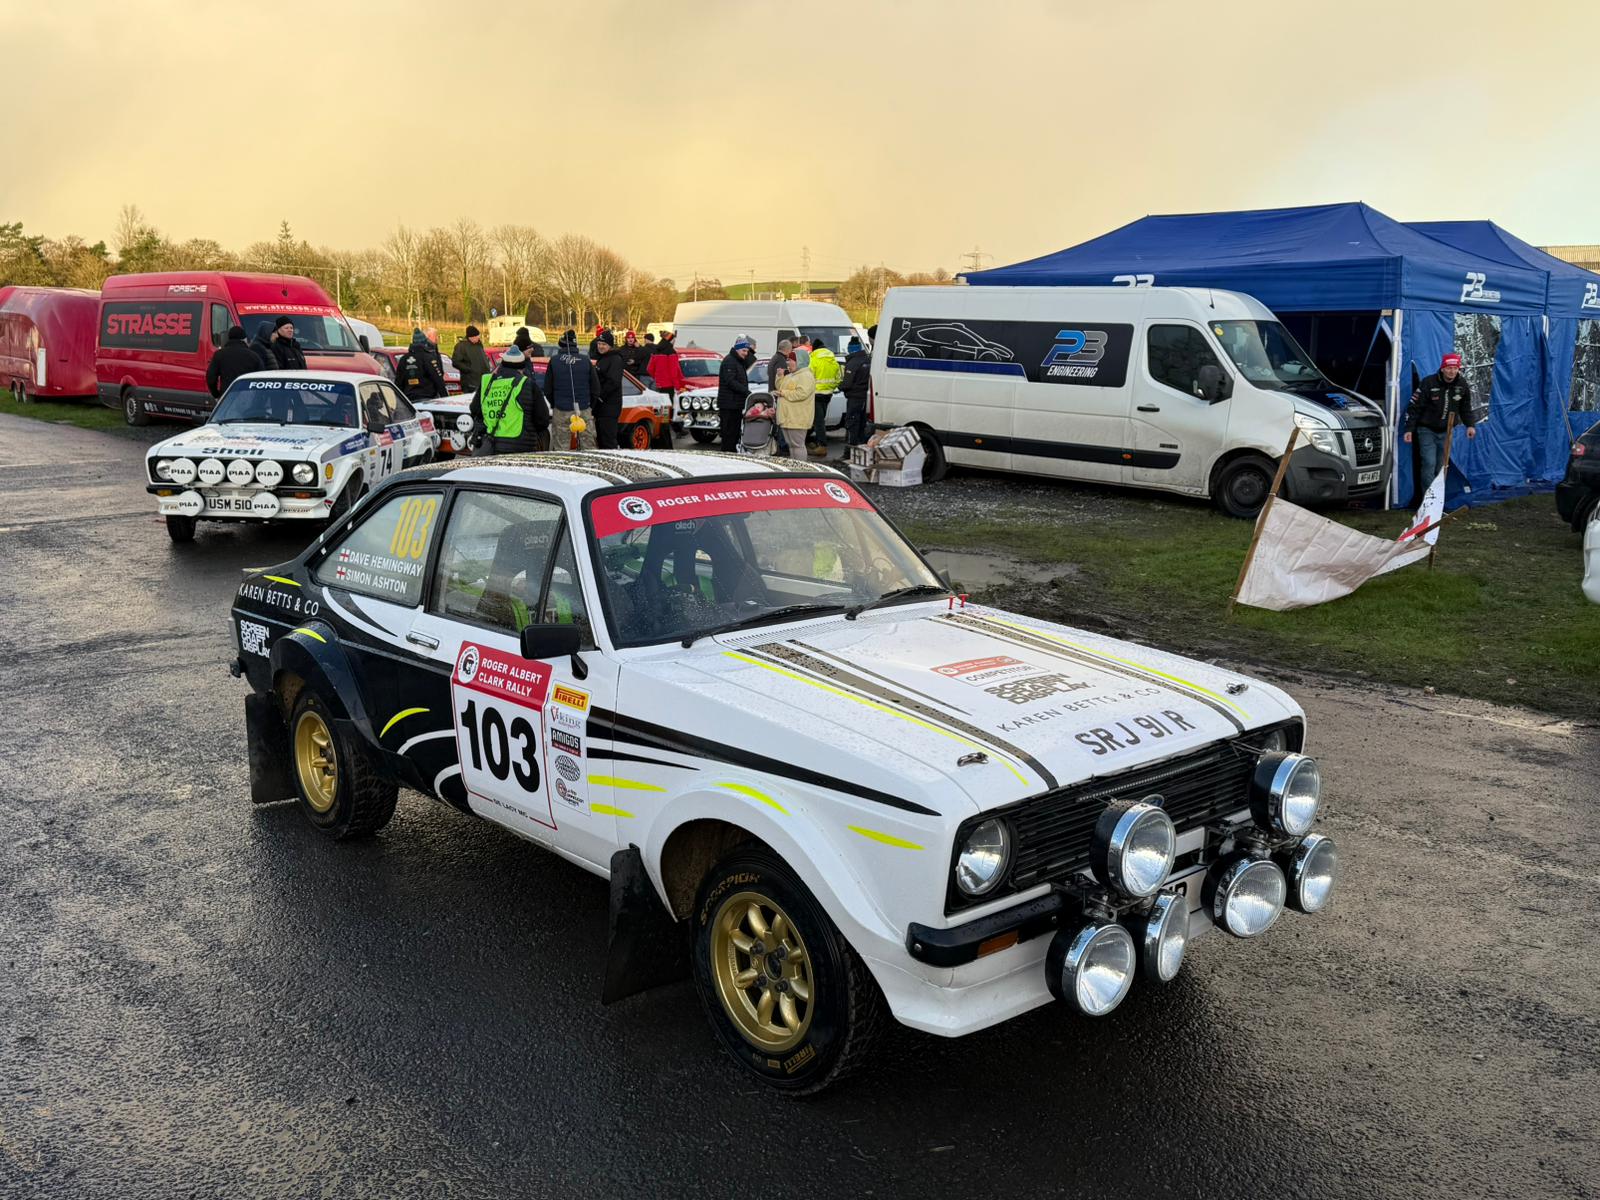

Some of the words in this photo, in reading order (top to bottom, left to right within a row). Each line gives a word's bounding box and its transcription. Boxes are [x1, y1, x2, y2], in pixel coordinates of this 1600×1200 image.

[168, 285, 208, 293] PORSCHE
[107, 313, 192, 336] STRASSE
[1047, 365, 1098, 378] ENGINEERING
[249, 381, 281, 390] FORD
[284, 382, 335, 391] ESCORT
[202, 447, 264, 456] Shell
[381, 448, 392, 476] 74
[209, 499, 231, 510] USM
[234, 499, 252, 510] 510
[656, 494, 701, 508] ROGER
[704, 490, 748, 503] ALBERT
[751, 488, 788, 498] CLARK
[791, 487, 821, 496] RALLY
[390, 497, 436, 561] 103
[349, 551, 370, 566] DAVE
[371, 556, 422, 576] HEMINGWAY
[346, 569, 371, 585] SIMON
[372, 576, 407, 594] ASHTON
[239, 583, 264, 602] KAREN
[266, 590, 292, 609] BETTS
[294, 598, 300, 612] &
[304, 600, 319, 616] CO
[241, 620, 269, 638] SCREEN
[241, 631, 265, 647] CRAFT
[481, 658, 509, 674] ROGER
[509, 667, 542, 684] ALBERT
[965, 665, 1035, 682] COMPETITOR
[478, 672, 504, 688] CLARK
[506, 680, 532, 697] RALLY
[984, 673, 1070, 695] SCREEN
[996, 679, 1069, 699] CRAFT
[555, 687, 586, 708] PIRELLI
[551, 706, 581, 729] Viking
[997, 708, 1063, 733] KAREN
[1063, 695, 1117, 713] BETTS
[1117, 692, 1135, 701] &
[1134, 687, 1161, 697] CO
[460, 699, 541, 793] 103
[552, 730, 579, 748] AMIGOS
[1074, 722, 1141, 756] SRJ
